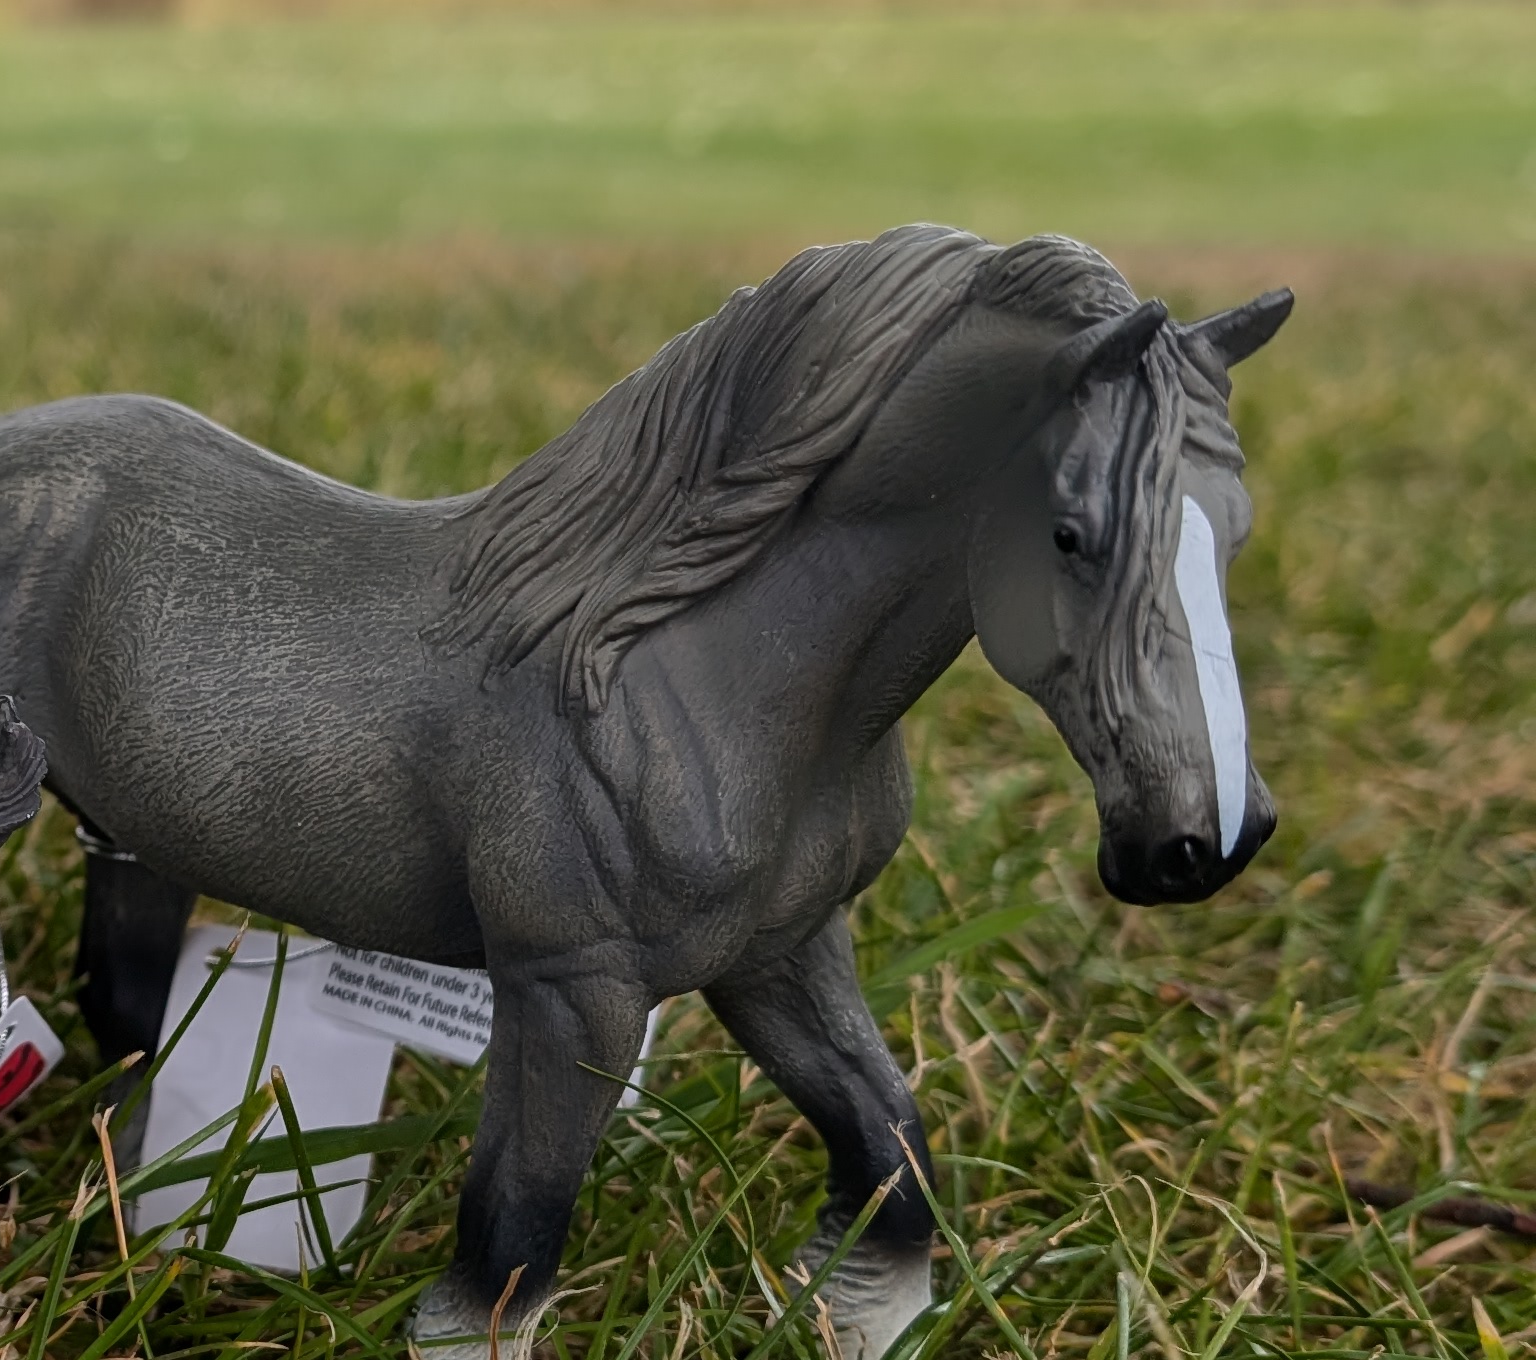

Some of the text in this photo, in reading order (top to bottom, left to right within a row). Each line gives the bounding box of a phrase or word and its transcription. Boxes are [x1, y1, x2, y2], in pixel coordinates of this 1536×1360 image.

[329, 961, 364, 987] Please
[365, 974, 400, 999] Retain
[401, 986, 422, 1006] For
[421, 991, 458, 1018] Future
[360, 951, 378, 967] for
[379, 956, 428, 983] children
[431, 973, 469, 994] under
[470, 982, 480, 999] 3
[323, 984, 358, 1004] MADE
[359, 995, 373, 1008] IN
[374, 1000, 414, 1022] CHINA.
[418, 1015, 435, 1029] All
[435, 1020, 472, 1040] Rights
